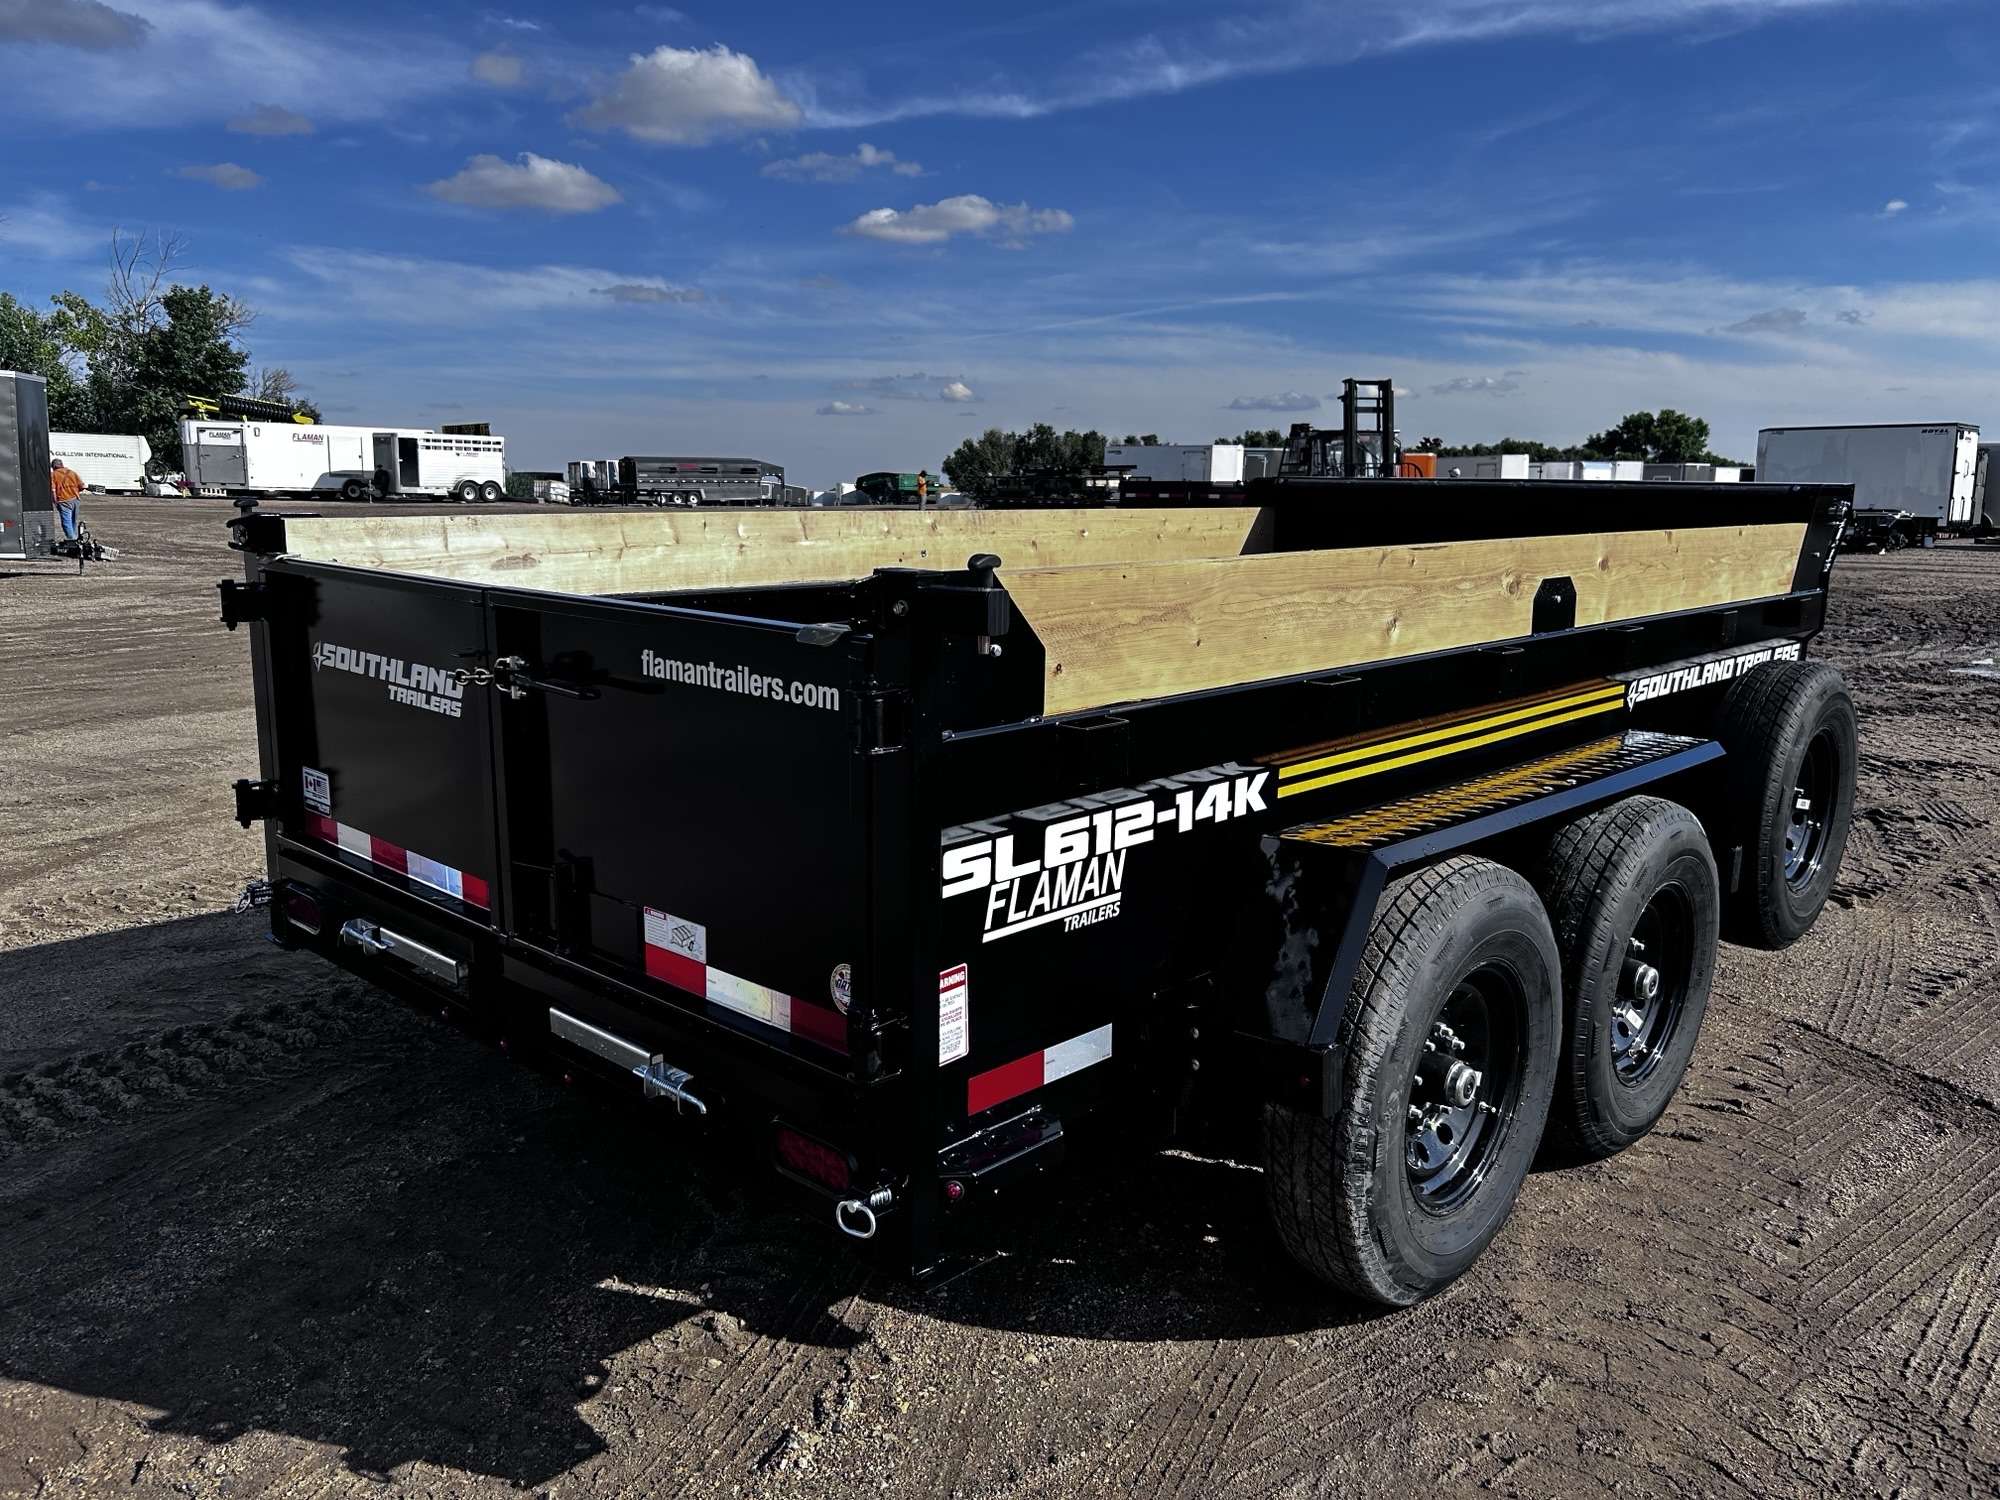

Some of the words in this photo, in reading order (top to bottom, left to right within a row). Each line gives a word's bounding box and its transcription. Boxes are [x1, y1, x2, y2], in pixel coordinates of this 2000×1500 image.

[208, 431, 231, 440] FLAMAN
[292, 432, 324, 441] FLAMAN
[85, 451, 128, 459] INTERNATIONAL
[322, 643, 464, 699] SOUTHLAND
[641, 649, 840, 711] flamantrailers.com
[1635, 657, 1736, 703] SOUTHLAND
[388, 684, 462, 718] TRAILERS
[942, 771, 1270, 899] SL612-14K
[984, 848, 1127, 931] FLAMAN
[1063, 901, 1121, 933] TRAILERS
[940, 971, 966, 990] ARNING
